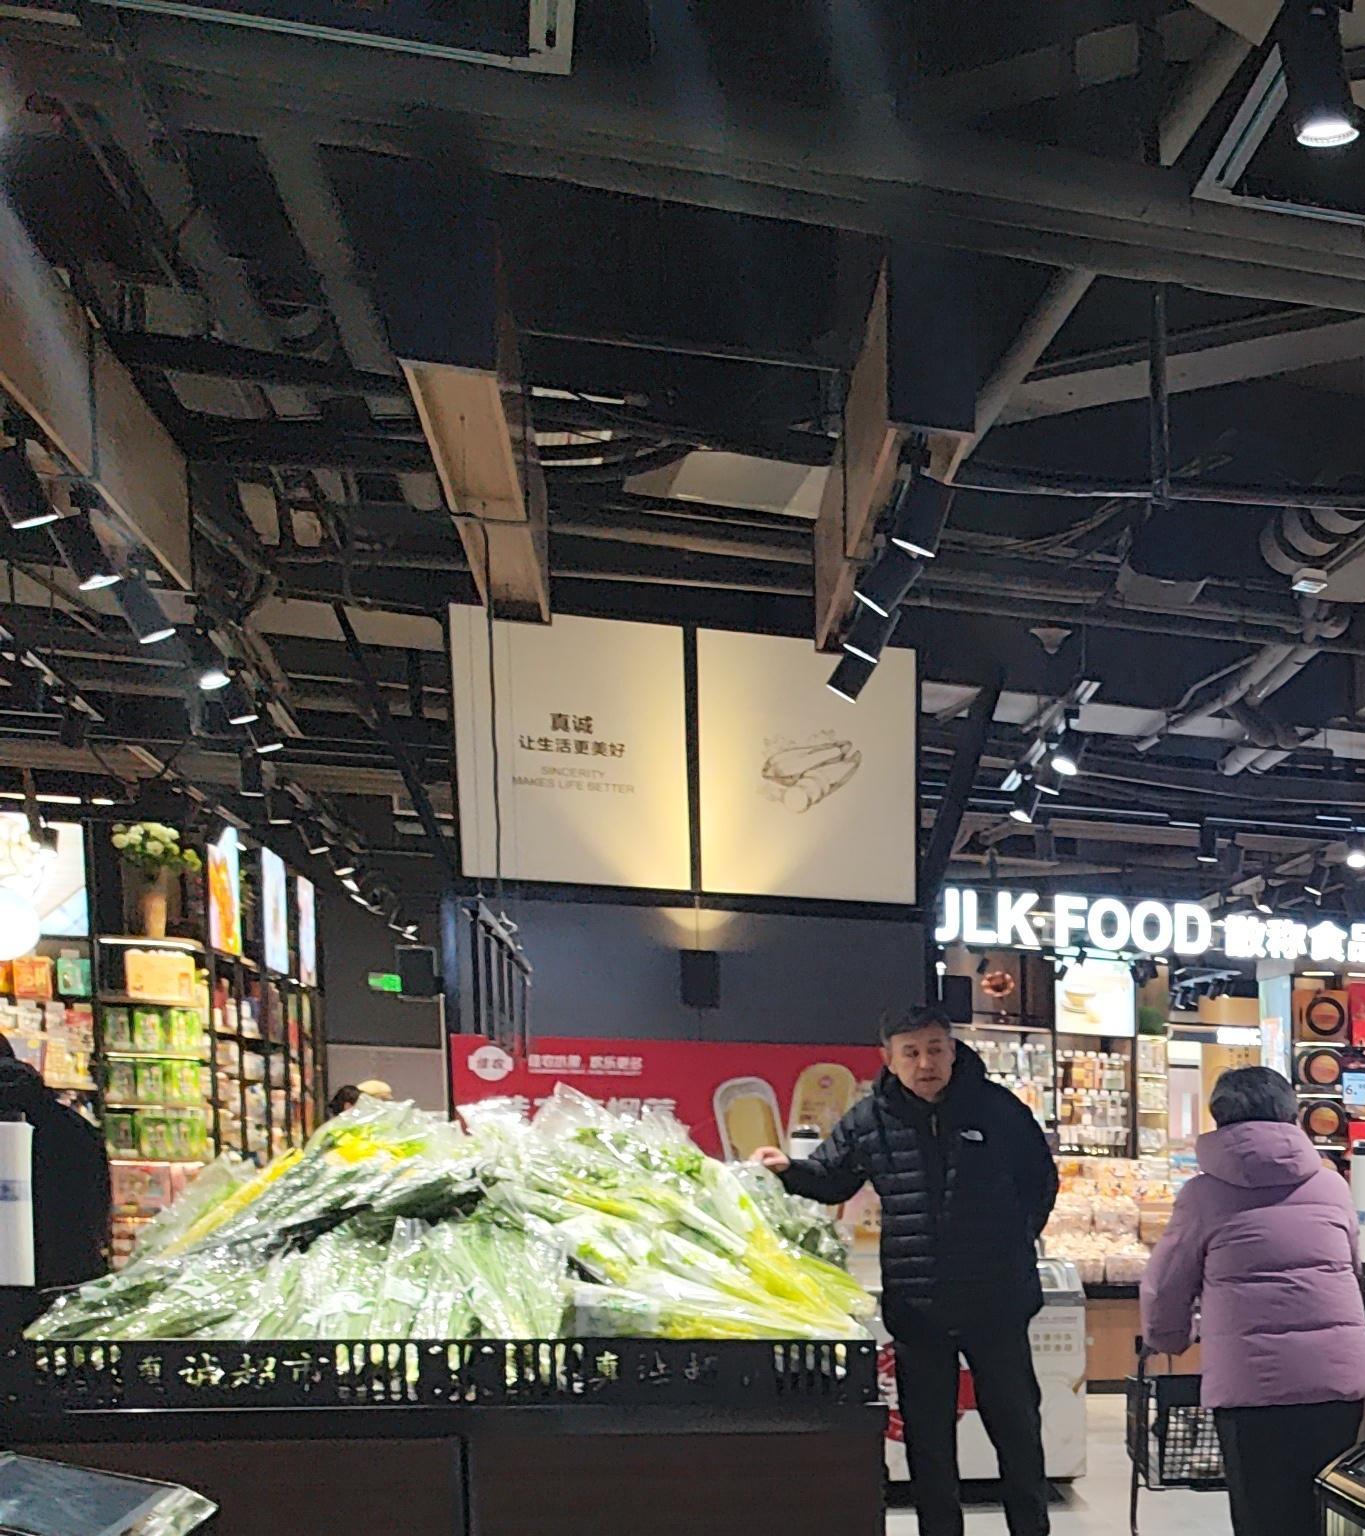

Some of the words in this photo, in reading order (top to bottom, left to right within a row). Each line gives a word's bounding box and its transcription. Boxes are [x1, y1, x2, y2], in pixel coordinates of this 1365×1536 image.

[550, 712, 594, 735] 真诚
[518, 734, 627, 759] 让生活更美好
[541, 766, 606, 779] SINCERITY
[512, 775, 554, 789] MAKES
[559, 780, 584, 791] LIFE
[587, 782, 635, 795] BETTER
[934, 887, 1040, 946] JLK
[1053, 893, 1213, 955] FOOD
